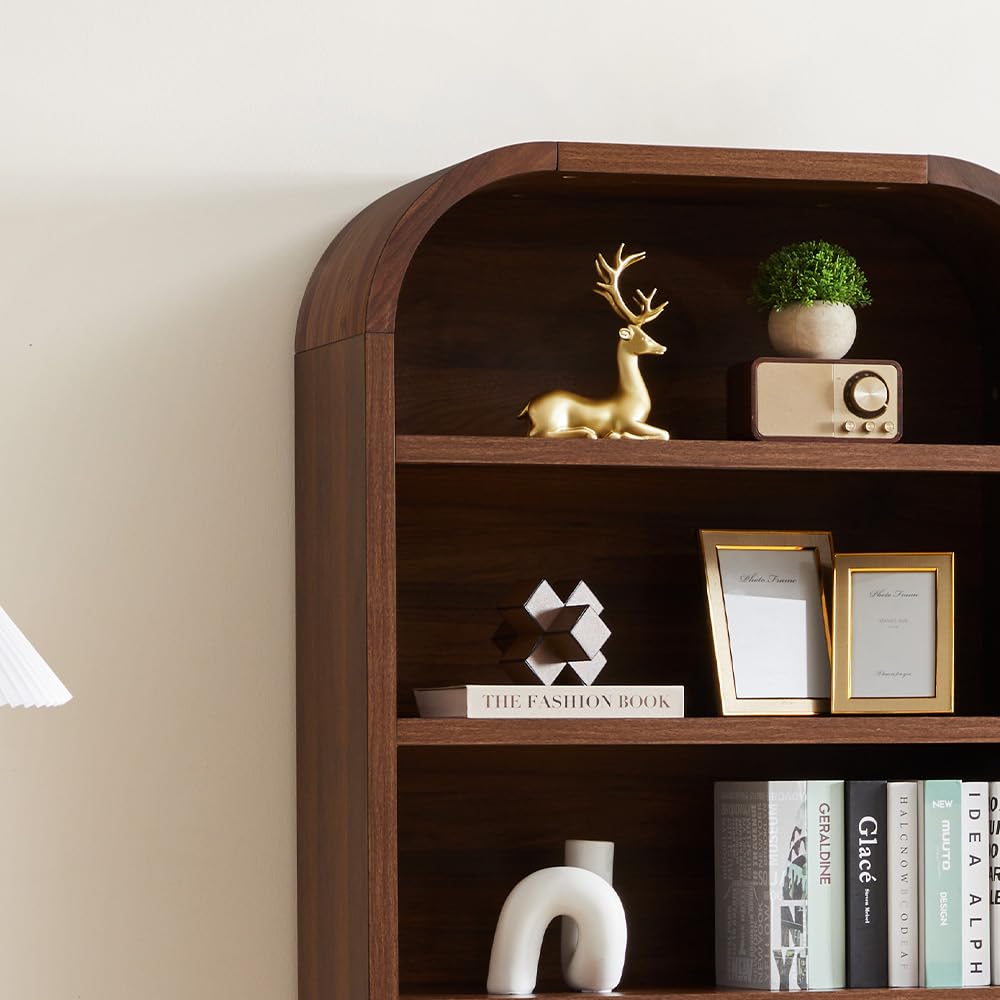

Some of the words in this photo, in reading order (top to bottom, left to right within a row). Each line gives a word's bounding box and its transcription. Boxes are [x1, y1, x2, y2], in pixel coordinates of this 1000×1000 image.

[482, 694, 522, 709] THE
[527, 694, 612, 709] FASHION
[619, 694, 671, 709] BOOK
[932, 799, 953, 809] NEW
[818, 802, 831, 886] GERALDINE
[858, 815, 878, 883] Glacé
[939, 891, 949, 927] DESIGN
